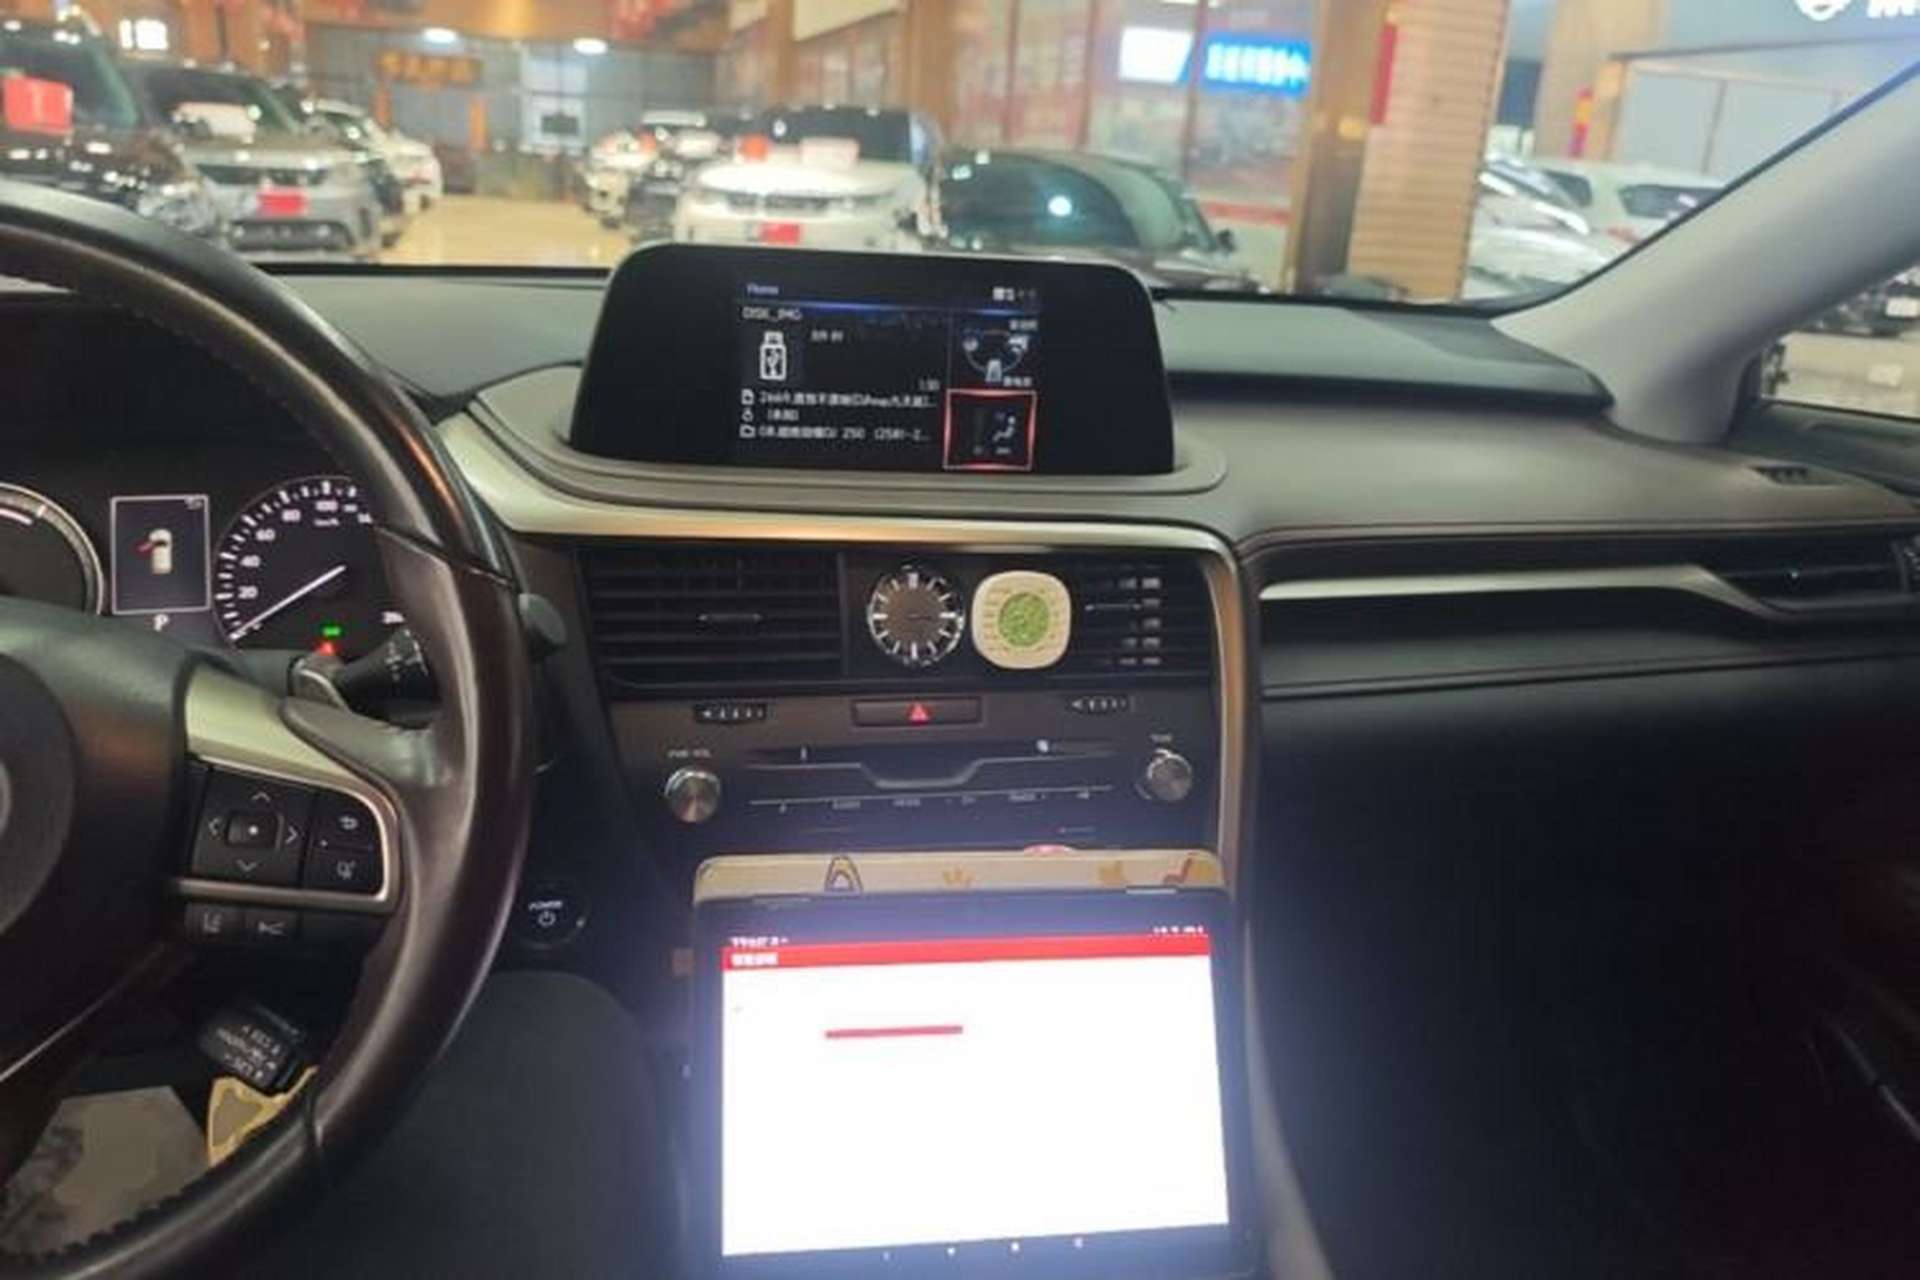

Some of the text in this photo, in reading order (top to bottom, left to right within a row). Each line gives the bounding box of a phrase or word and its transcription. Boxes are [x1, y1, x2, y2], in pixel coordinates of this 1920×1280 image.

[255, 529, 276, 541] 60
[240, 555, 261, 567] 40
[238, 586, 258, 599] 20
[153, 614, 169, 631] P
